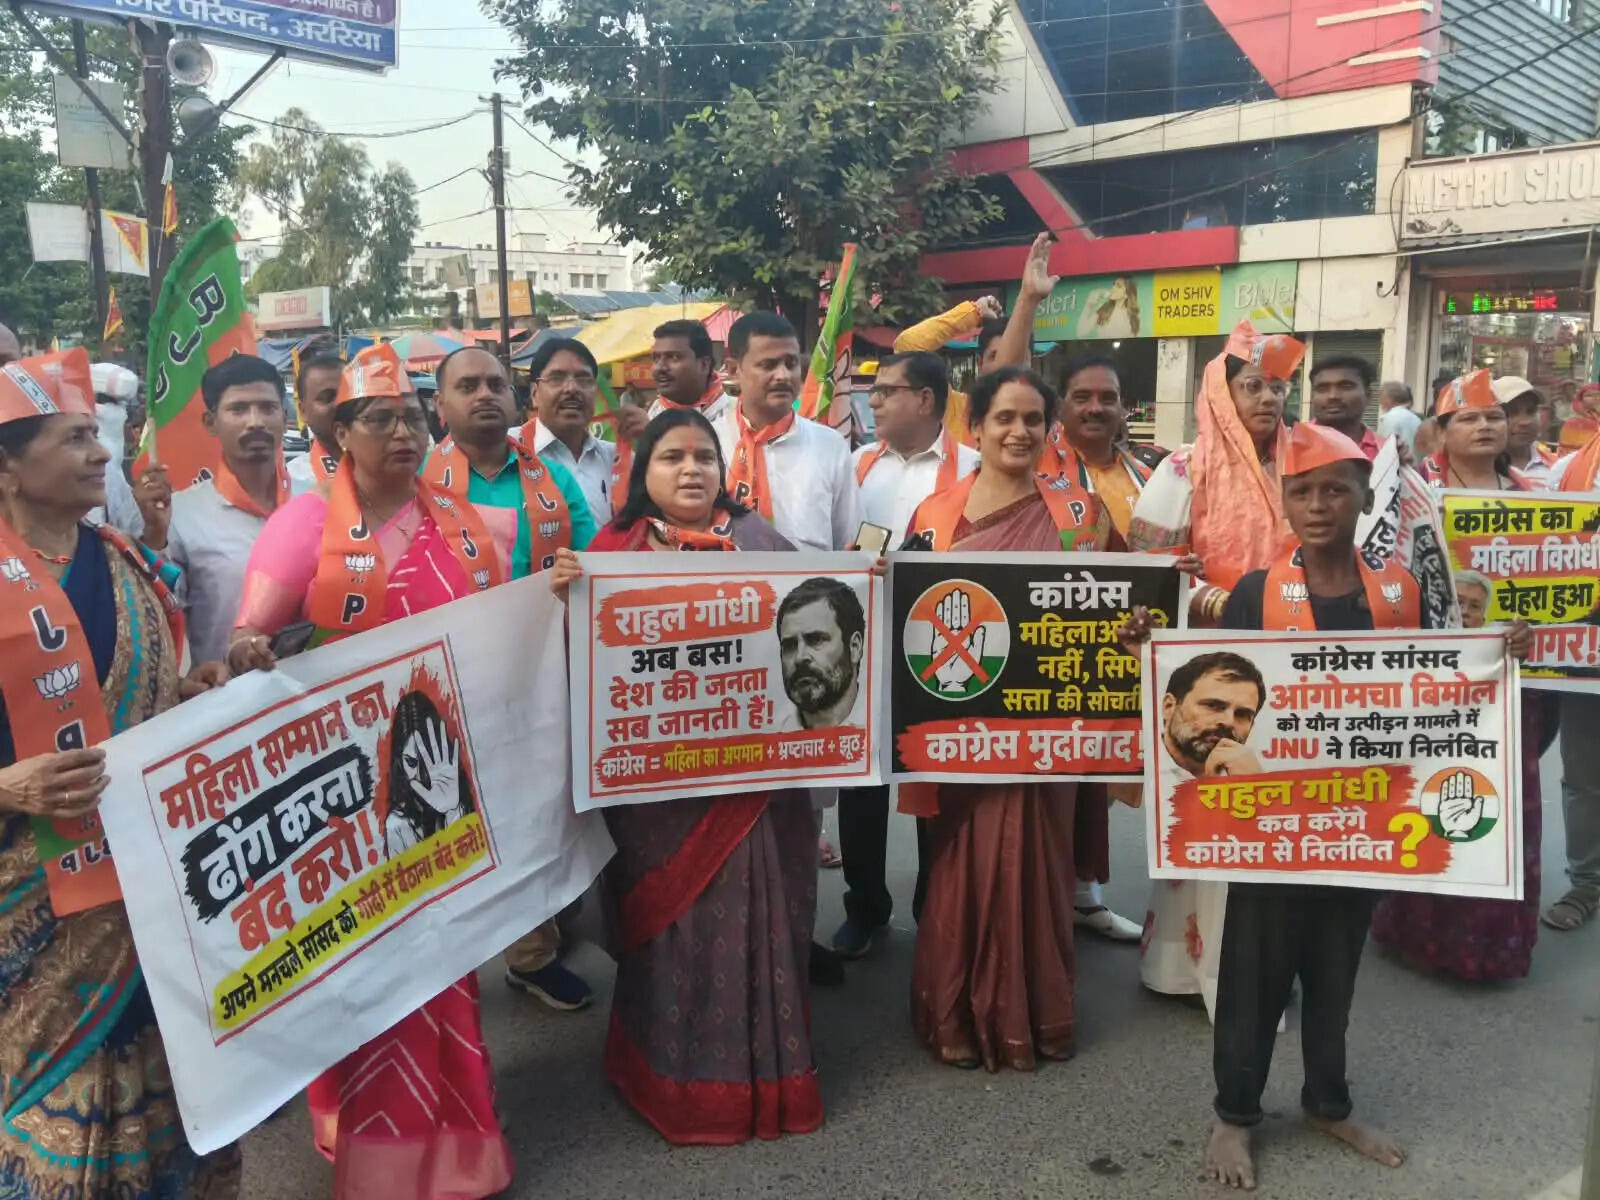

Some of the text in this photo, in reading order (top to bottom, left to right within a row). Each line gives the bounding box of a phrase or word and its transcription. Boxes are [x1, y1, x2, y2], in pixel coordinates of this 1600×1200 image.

[287, 18, 383, 52] अररिया
[1407, 166, 1512, 216] METRO
[1157, 303, 1216, 321] TRADERS
[1160, 286, 1213, 301] OM SHIV
[1067, 500, 1087, 526] P
[1452, 500, 1536, 535] कांग्रेस
[1539, 507, 1575, 531] का
[461, 527, 479, 559] J
[1470, 536, 1540, 577] महिला
[340, 592, 367, 624] P
[1027, 570, 1133, 611] कांग्रेस
[1496, 580, 1549, 618] चेहरा
[1551, 583, 1595, 619] हुआ
[613, 586, 762, 643] राहुल गांधी
[631, 638, 744, 674] अब बस!
[1037, 647, 1090, 683] नहीं,
[1290, 644, 1461, 673] कांग्रेस सांसद
[609, 667, 769, 712] देश की जनता
[1001, 687, 1053, 713] सत्ता
[1055, 685, 1083, 712] की
[1269, 671, 1499, 712] आंगोमचा बिमोल
[606, 714, 652, 745] सब
[656, 697, 741, 736] जानती
[1276, 707, 1481, 736] को यौन उत्पीड़न मामले में
[159, 680, 390, 830] महिला सम्मान का
[600, 749, 648, 779] कांग्रेस
[663, 742, 701, 773] महिला
[703, 748, 720, 767] का
[721, 742, 765, 766] अपमान
[777, 738, 825, 760] भ्रष्टाचार
[924, 721, 1022, 764] कांग्रेस
[1261, 732, 1499, 760] JNU ने किया निलंबित
[1197, 767, 1392, 821] राहुल गांधी
[200, 760, 365, 901] ढोंग करना
[1256, 805, 1369, 834] कब करेंगे
[1184, 834, 1396, 866] कांग्रेस से निलंबित
[1387, 811, 1431, 869] ?
[230, 810, 380, 953] बंद करो!
[219, 972, 257, 1020] अपने
[298, 918, 341, 963] सांसद
[335, 902, 358, 935] को
[382, 875, 398, 901] में
[432, 841, 456, 872] बंद
[455, 823, 486, 860] करो!
